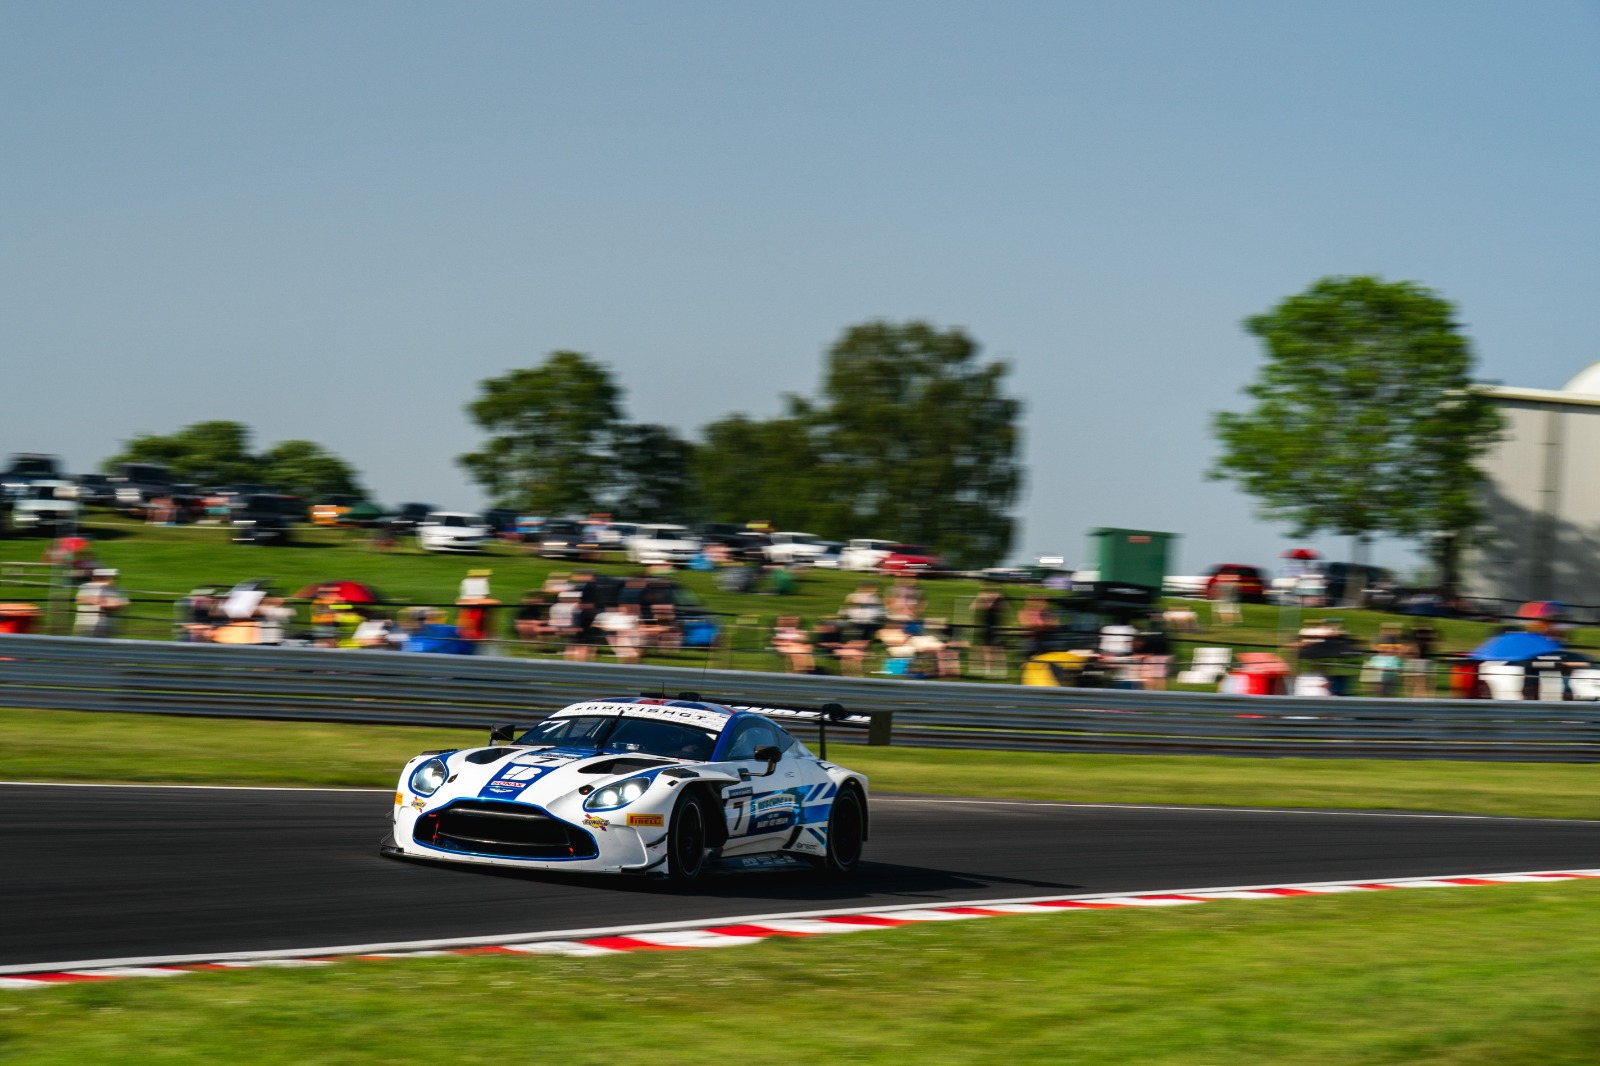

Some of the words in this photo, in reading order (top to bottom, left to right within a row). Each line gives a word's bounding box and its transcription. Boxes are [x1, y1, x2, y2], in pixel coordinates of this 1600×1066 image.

[538, 720, 570, 733] 7
[630, 815, 662, 824] PIRELLI
[733, 801, 744, 830] 7
